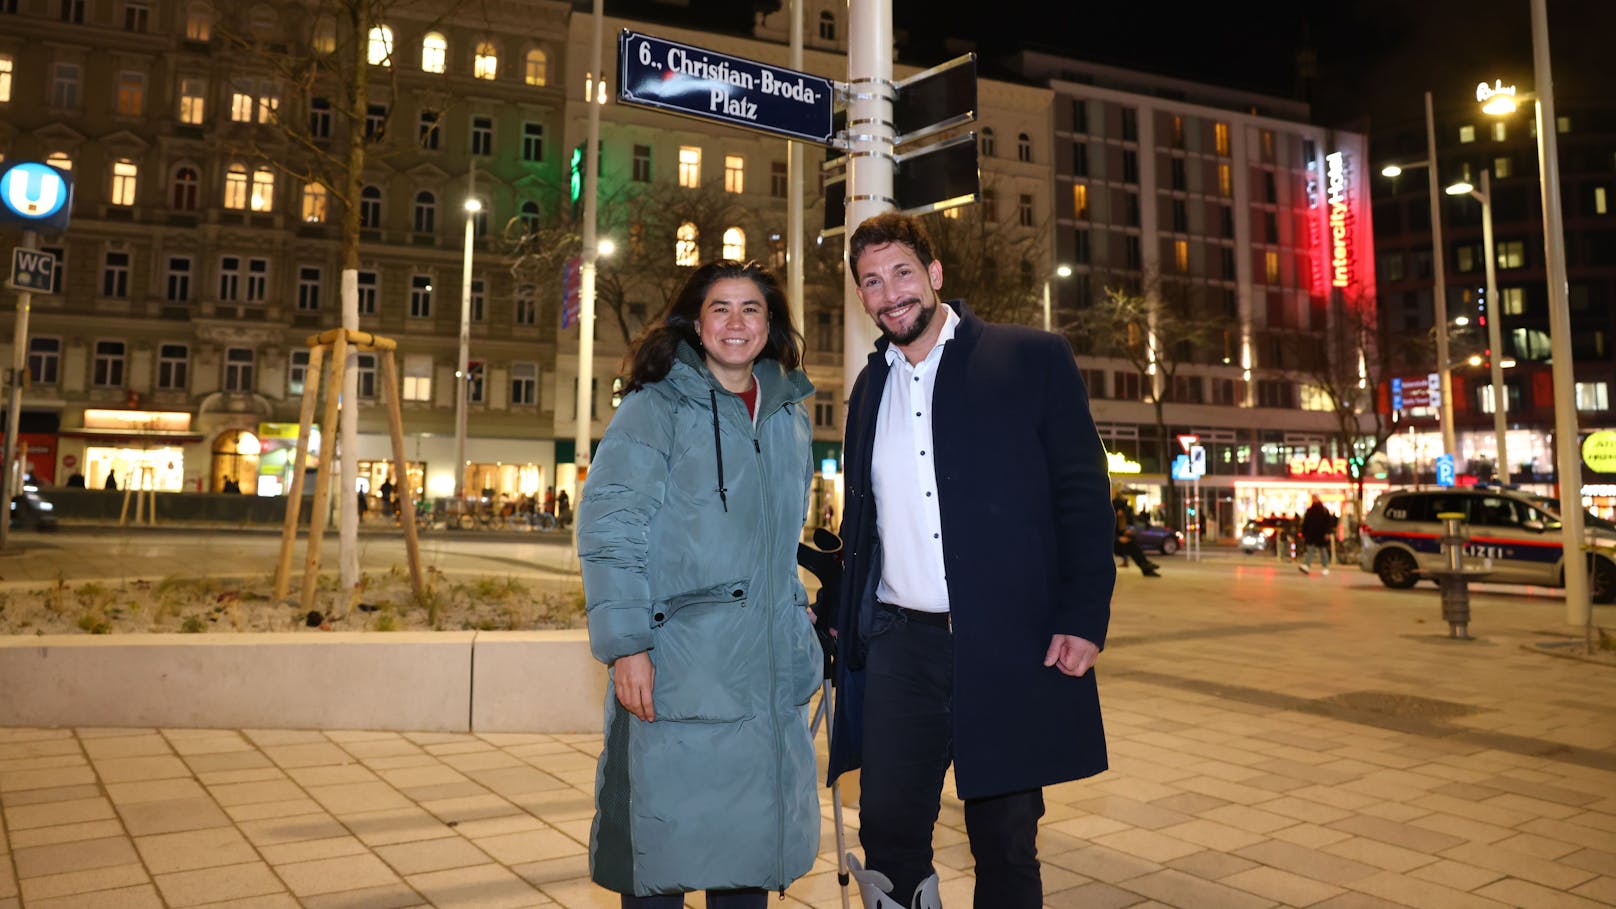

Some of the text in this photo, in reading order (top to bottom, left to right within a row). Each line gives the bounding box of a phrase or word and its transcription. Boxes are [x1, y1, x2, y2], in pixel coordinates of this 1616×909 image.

[638, 41, 822, 105] 6., Christian-Broda-
[709, 87, 758, 121] Platz
[9, 168, 60, 216] U
[1326, 151, 1348, 287] IntercityHotel
[18, 252, 51, 275] WC
[1290, 458, 1347, 475] SPAR
[1440, 543, 1503, 559] PLIZEI
